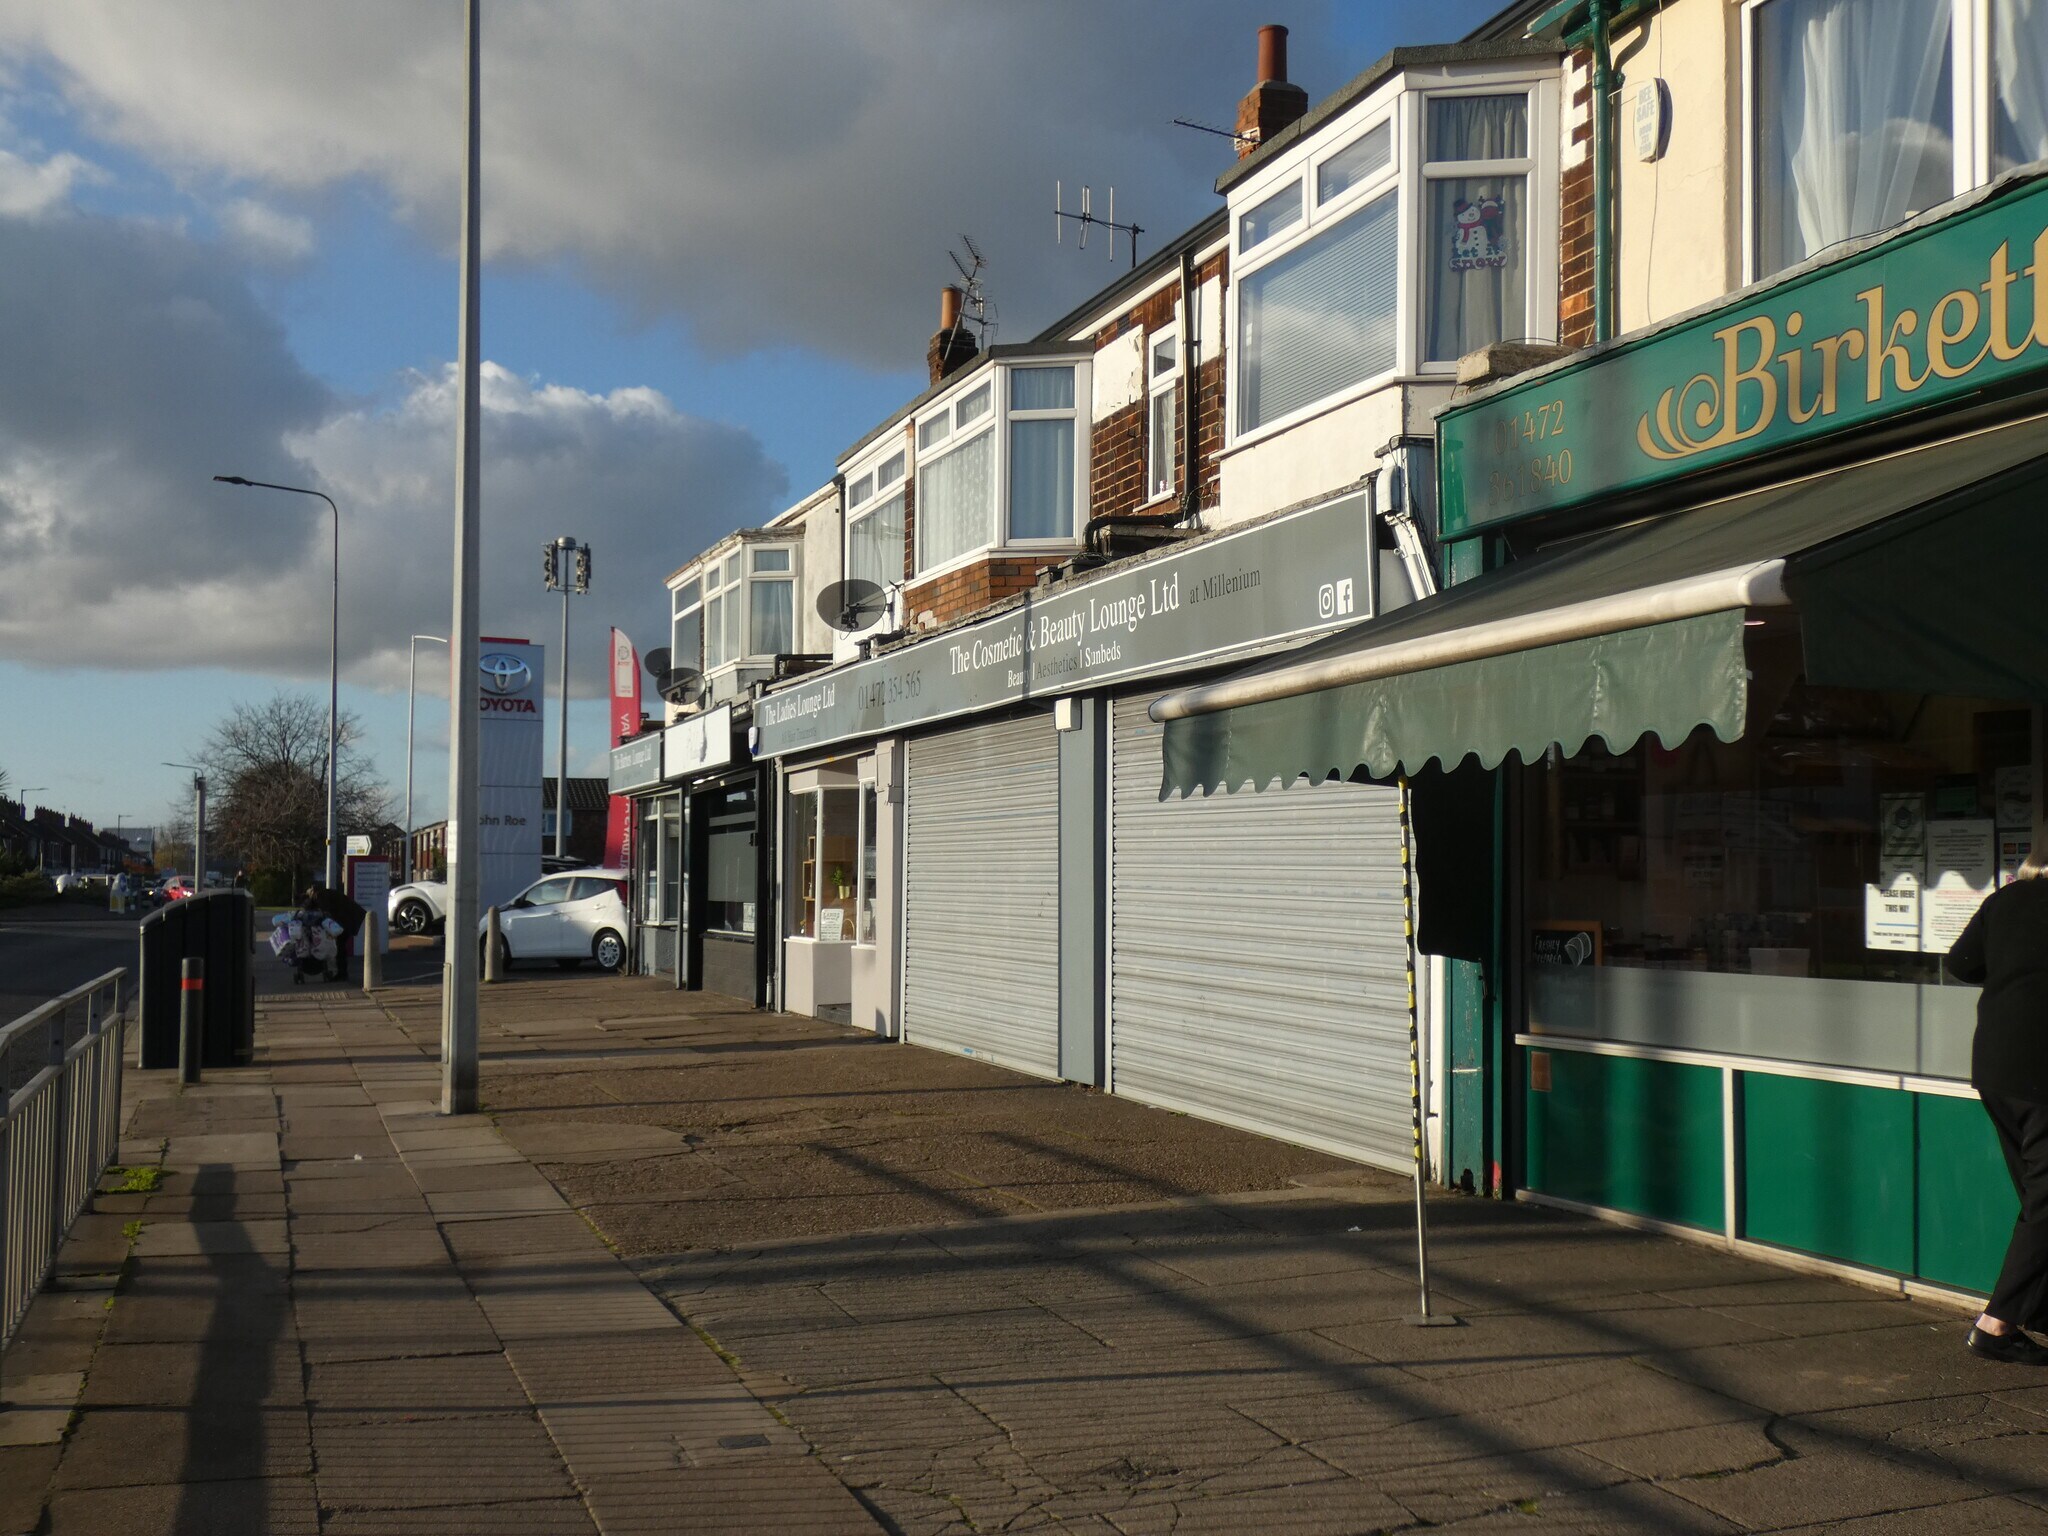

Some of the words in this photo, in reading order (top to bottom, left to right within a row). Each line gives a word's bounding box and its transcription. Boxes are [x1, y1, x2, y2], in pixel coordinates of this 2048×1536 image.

[1636, 99, 1655, 122] SAFE
[1451, 255, 1507, 272] snow
[1495, 398, 1565, 456] 01472
[1488, 447, 1574, 506] 361840
[949, 646, 970, 675] The
[972, 626, 1023, 669] Cosmetic
[1025, 621, 1036, 652] &
[1040, 611, 1085, 648] Beauty
[1089, 593, 1146, 633] Lounge
[1150, 571, 1179, 616] Ltd
[1189, 587, 1199, 605] at
[1203, 568, 1261, 601] Millenium
[1007, 668, 1031, 688] Beauty
[1036, 653, 1078, 680] Aesthetics
[480, 698, 537, 713] OYOTA
[765, 705, 776, 726] The
[777, 698, 796, 723] Ladies
[797, 694, 822, 718] Lounge
[822, 682, 836, 709] Ltd
[858, 680, 886, 710] 01472
[888, 675, 903, 704] 354
[905, 668, 921, 699] 565
[480, 813, 500, 826] ohn
[504, 815, 527, 826] Roe
[1885, 904, 1898, 912] THIS
